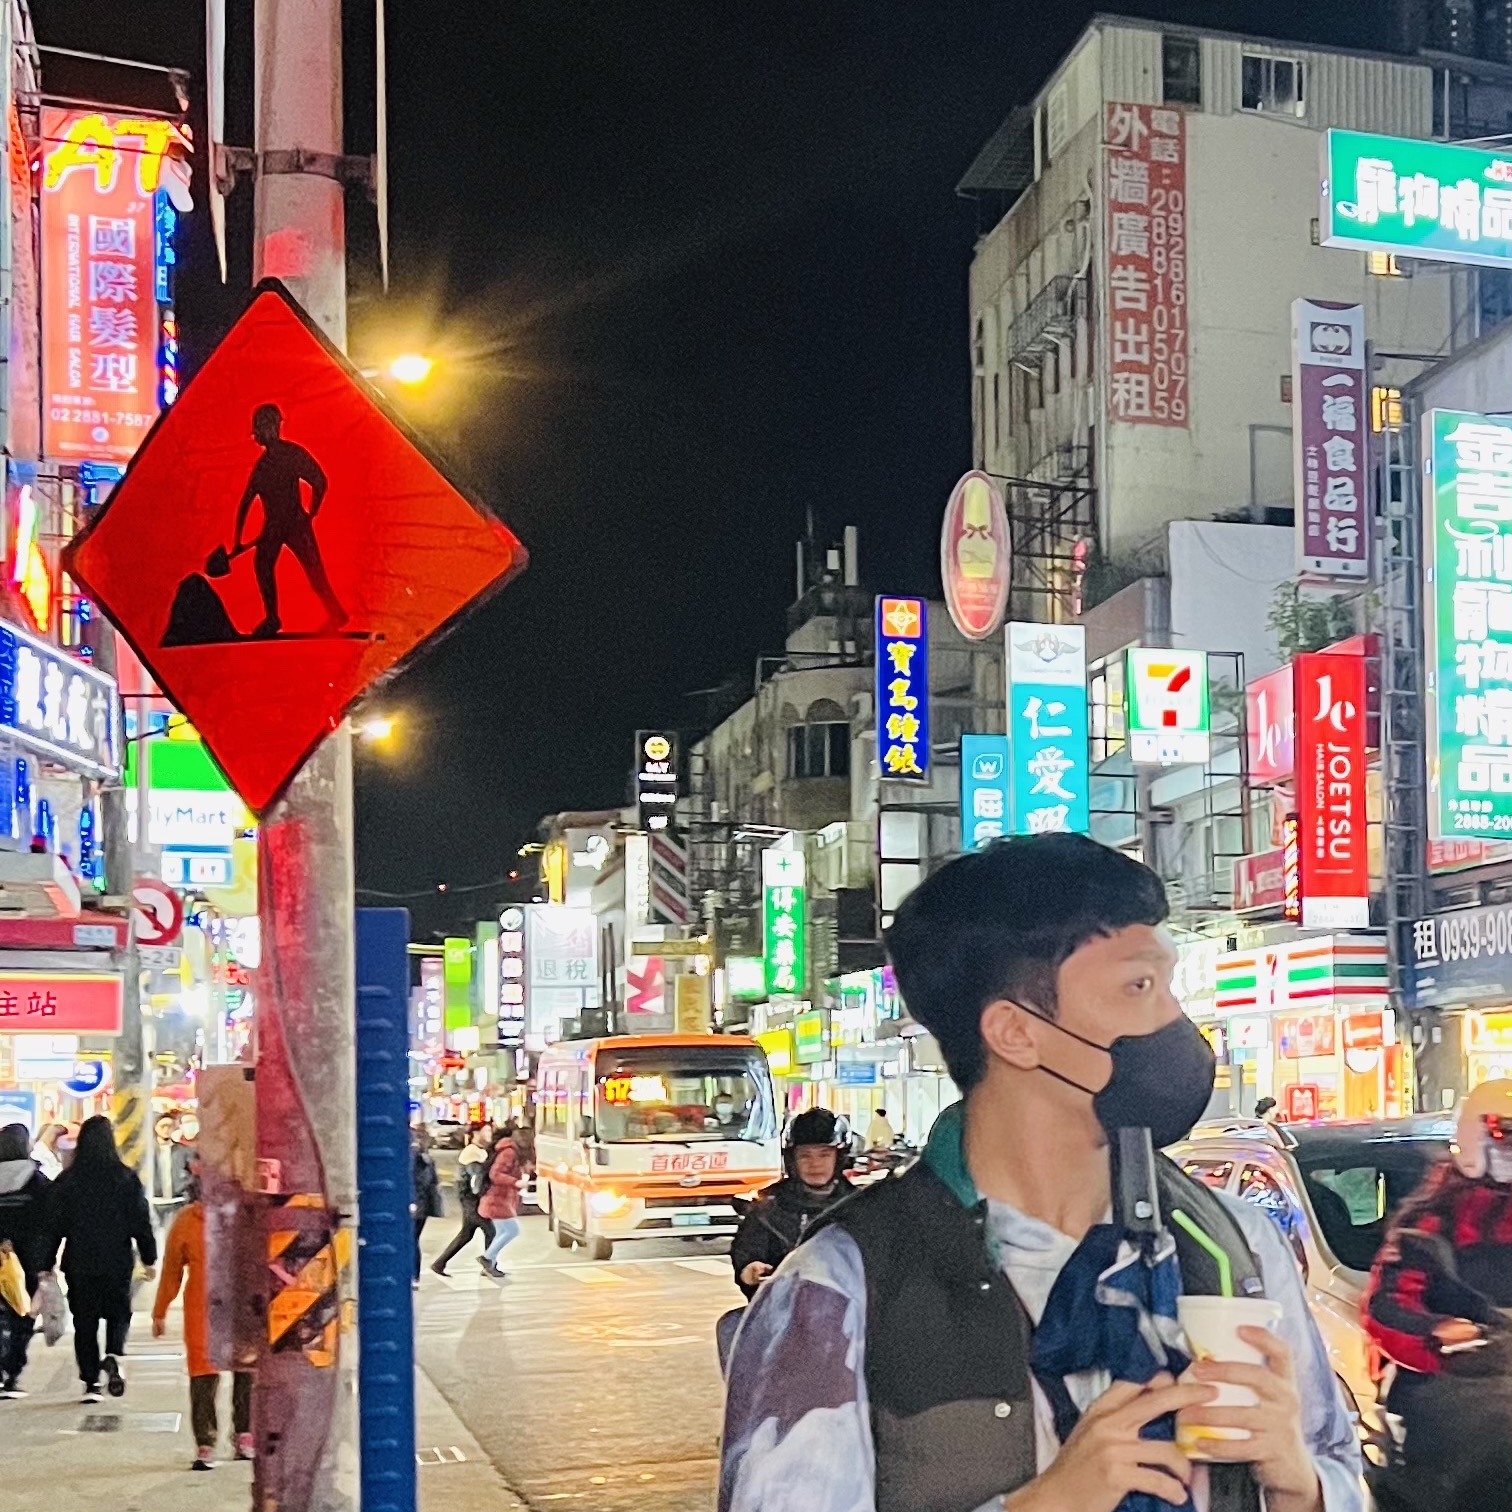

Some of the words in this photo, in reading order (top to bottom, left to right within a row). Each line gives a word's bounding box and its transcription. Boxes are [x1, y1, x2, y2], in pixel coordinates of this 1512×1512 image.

[88, 215, 139, 394] 國際髮型
[1110, 103, 1152, 417] 外牆廣告出租
[1151, 187, 1169, 419] 28810505
[1167, 189, 1186, 421] 0928617079
[1321, 373, 1359, 553] 一福食品行
[884, 640, 924, 775] 寶島鐘錶
[1315, 772, 1326, 809] SALON
[1328, 742, 1352, 860] JOETSU
[651, 1151, 729, 1171] 首都客運
